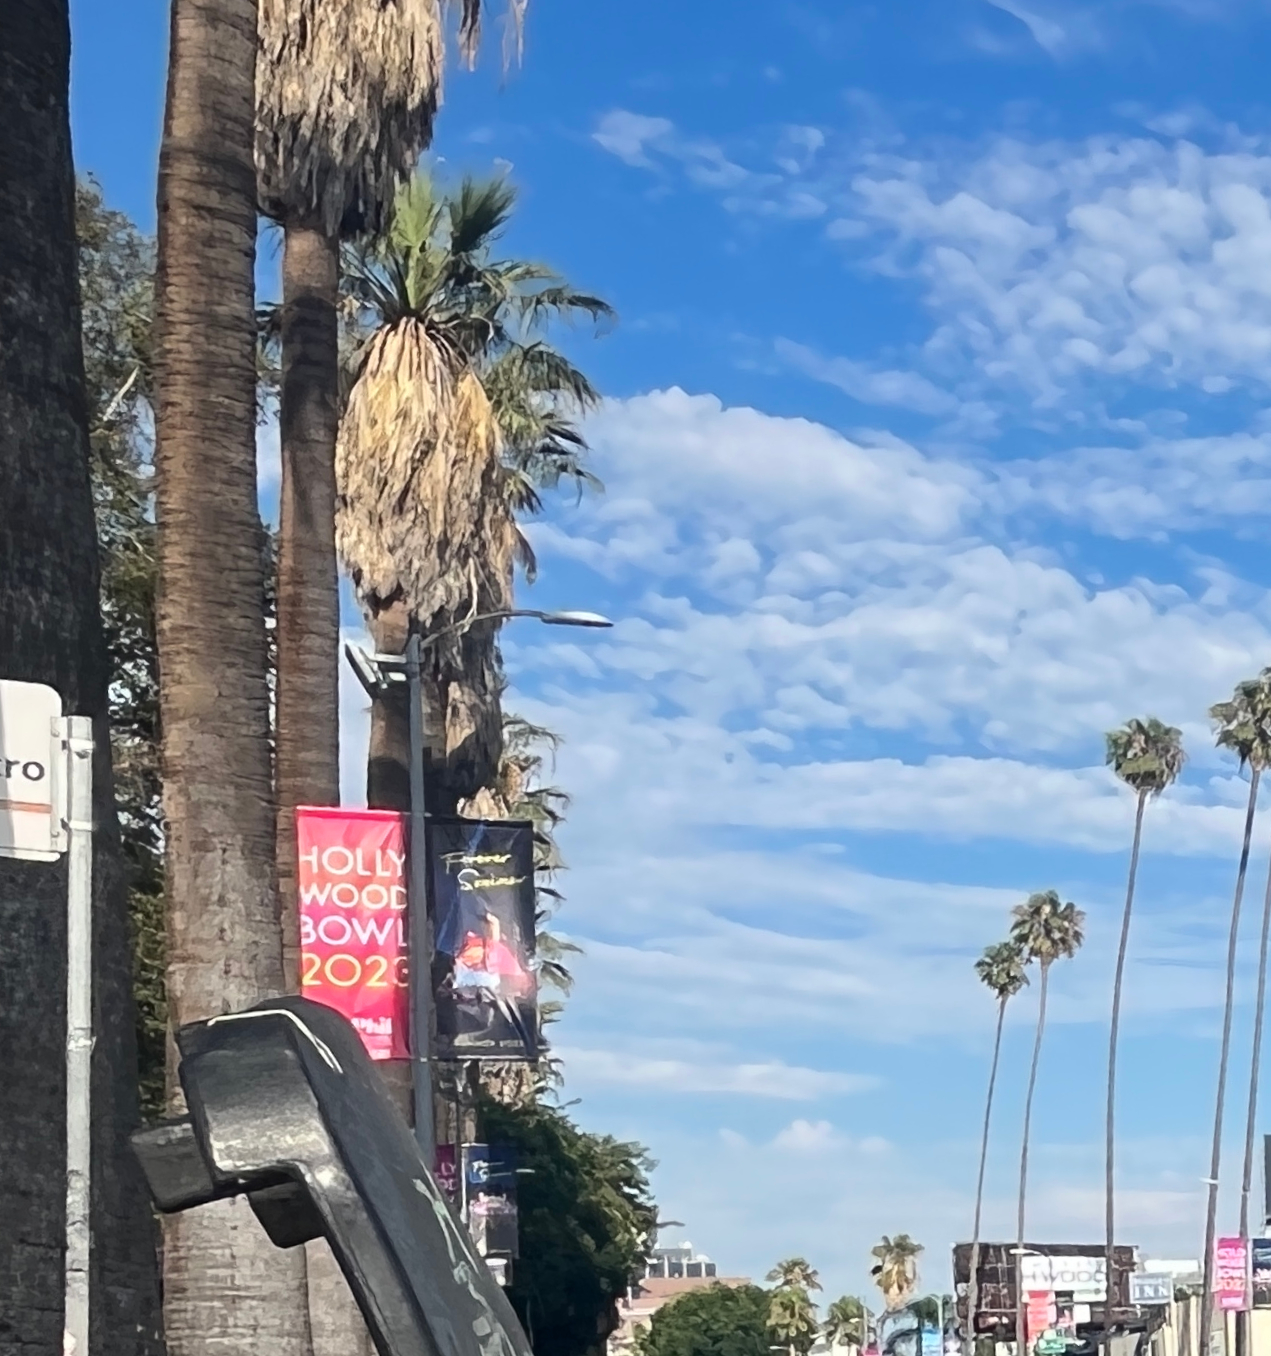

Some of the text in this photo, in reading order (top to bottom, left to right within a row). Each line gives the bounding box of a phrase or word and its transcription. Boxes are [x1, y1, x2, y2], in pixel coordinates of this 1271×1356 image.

[0, 757, 45, 782] ro
[300, 845, 405, 877] HOLLY
[300, 882, 408, 909] WOOD
[300, 915, 407, 946] BOWL
[1134, 1284, 1168, 1298] INN
